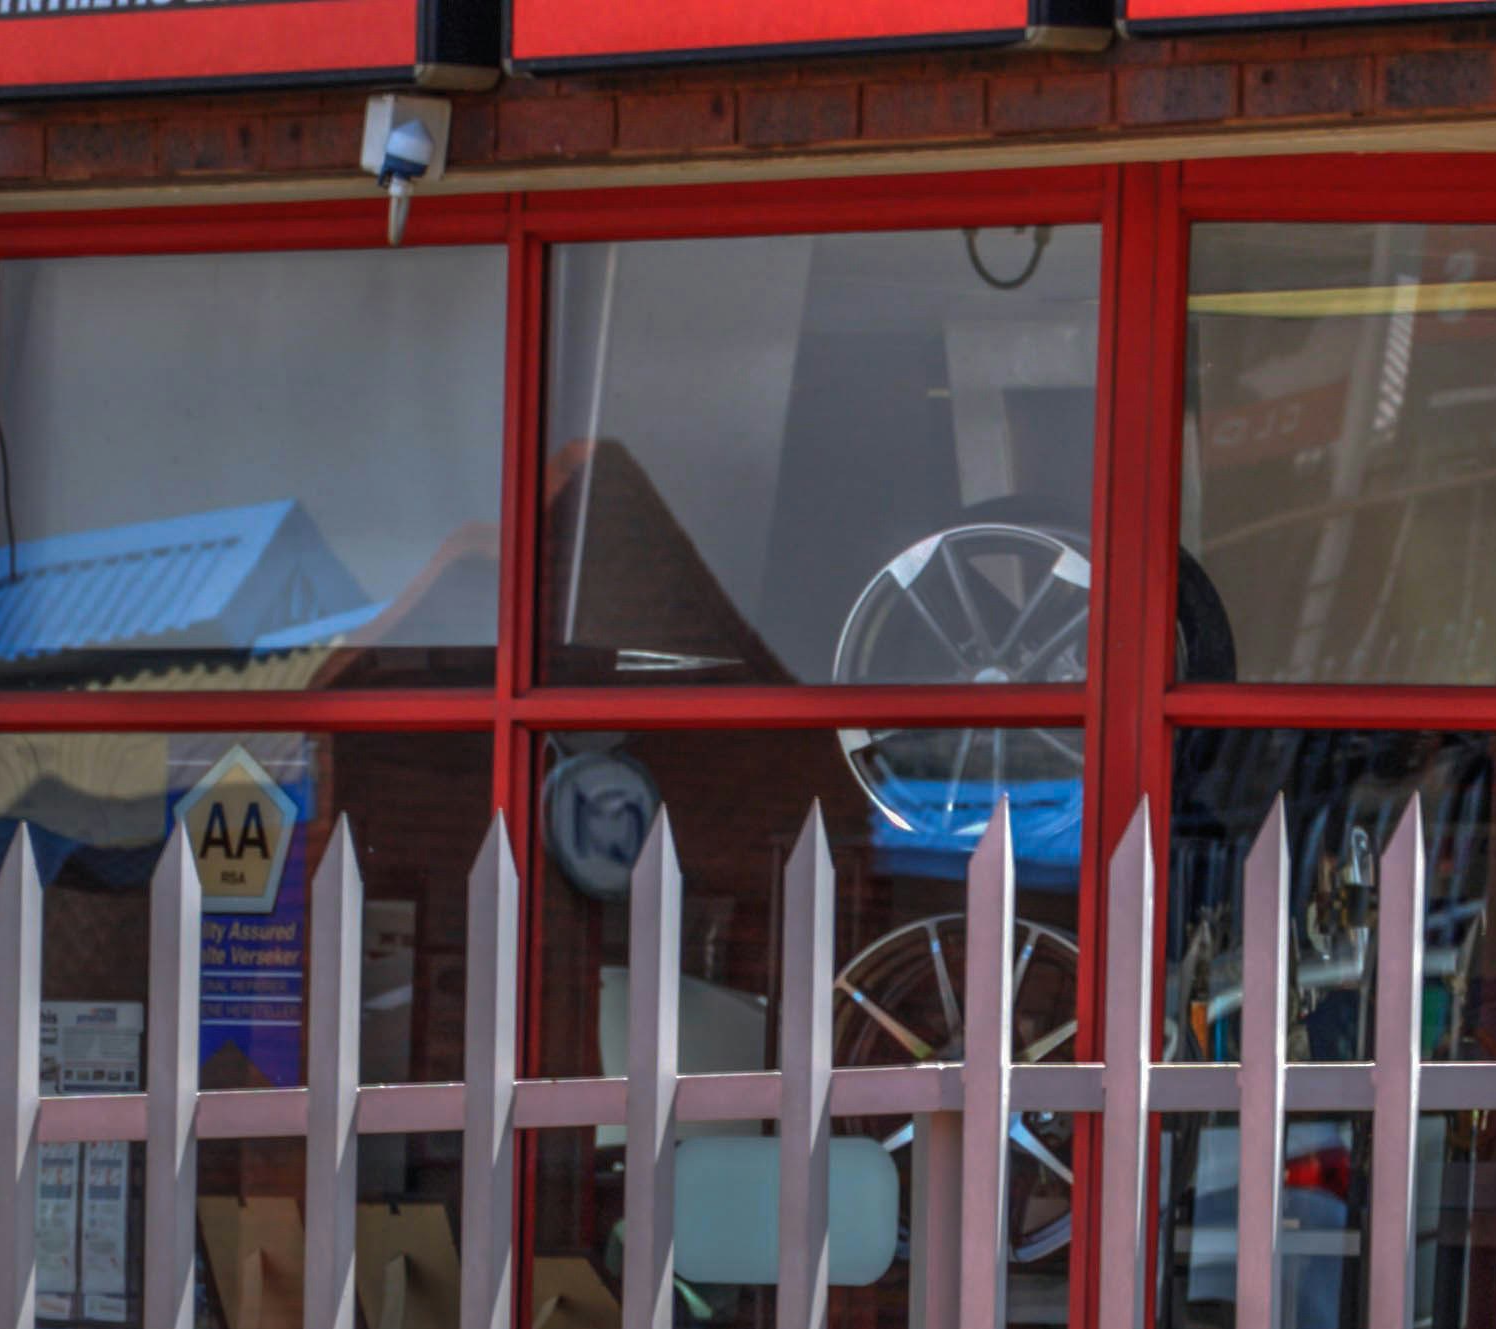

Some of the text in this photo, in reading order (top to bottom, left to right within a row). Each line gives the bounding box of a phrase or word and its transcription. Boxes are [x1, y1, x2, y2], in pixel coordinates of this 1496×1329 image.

[200, 802, 270, 860] AA
[220, 871, 246, 885] RSA
[228, 920, 296, 940] Assured
[230, 945, 299, 966] Verseker
